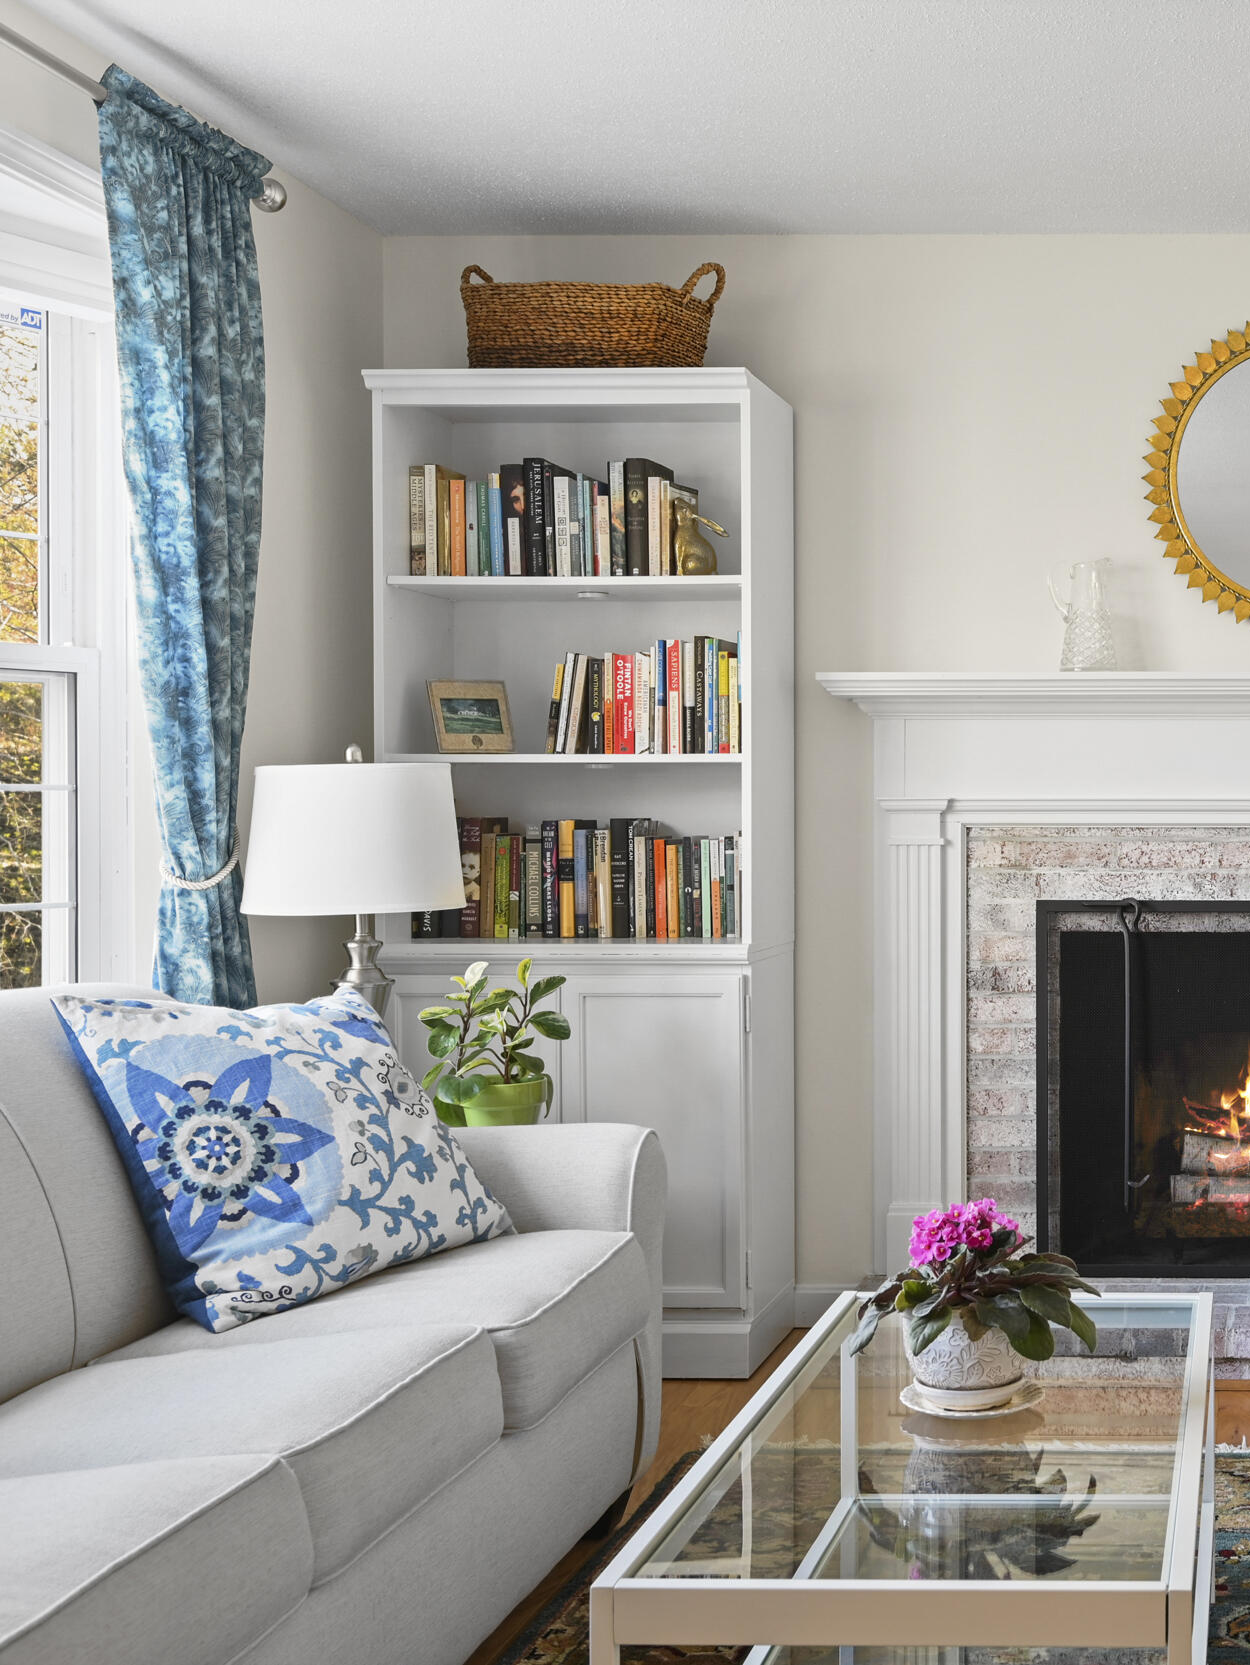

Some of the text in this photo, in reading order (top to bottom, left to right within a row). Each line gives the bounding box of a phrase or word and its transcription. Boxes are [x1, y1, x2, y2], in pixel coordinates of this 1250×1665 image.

[22, 311, 41, 327] ADT
[532, 462, 542, 523] JERUSALEM
[529, 851, 539, 917] MICHAEL COLLINS
